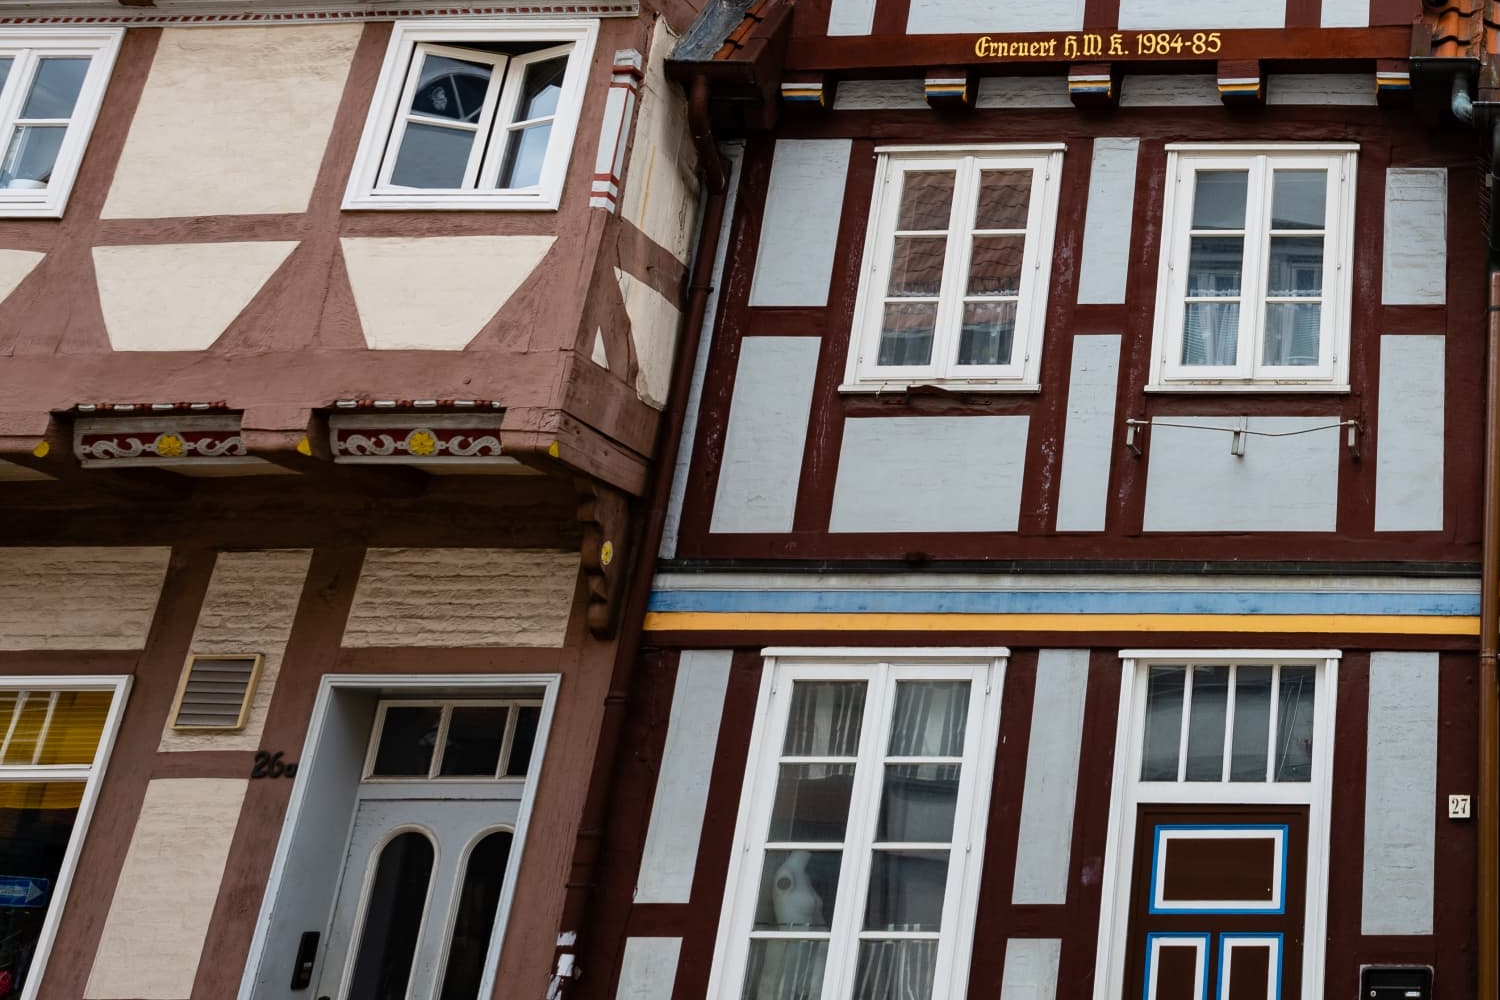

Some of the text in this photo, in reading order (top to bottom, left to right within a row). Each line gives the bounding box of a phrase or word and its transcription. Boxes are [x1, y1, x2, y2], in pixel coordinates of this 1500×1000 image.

[975, 36, 1057, 58] Erneuert
[1136, 32, 1222, 55] 1984-85
[251, 751, 298, 778] 26a
[1451, 798, 1468, 815] 27
